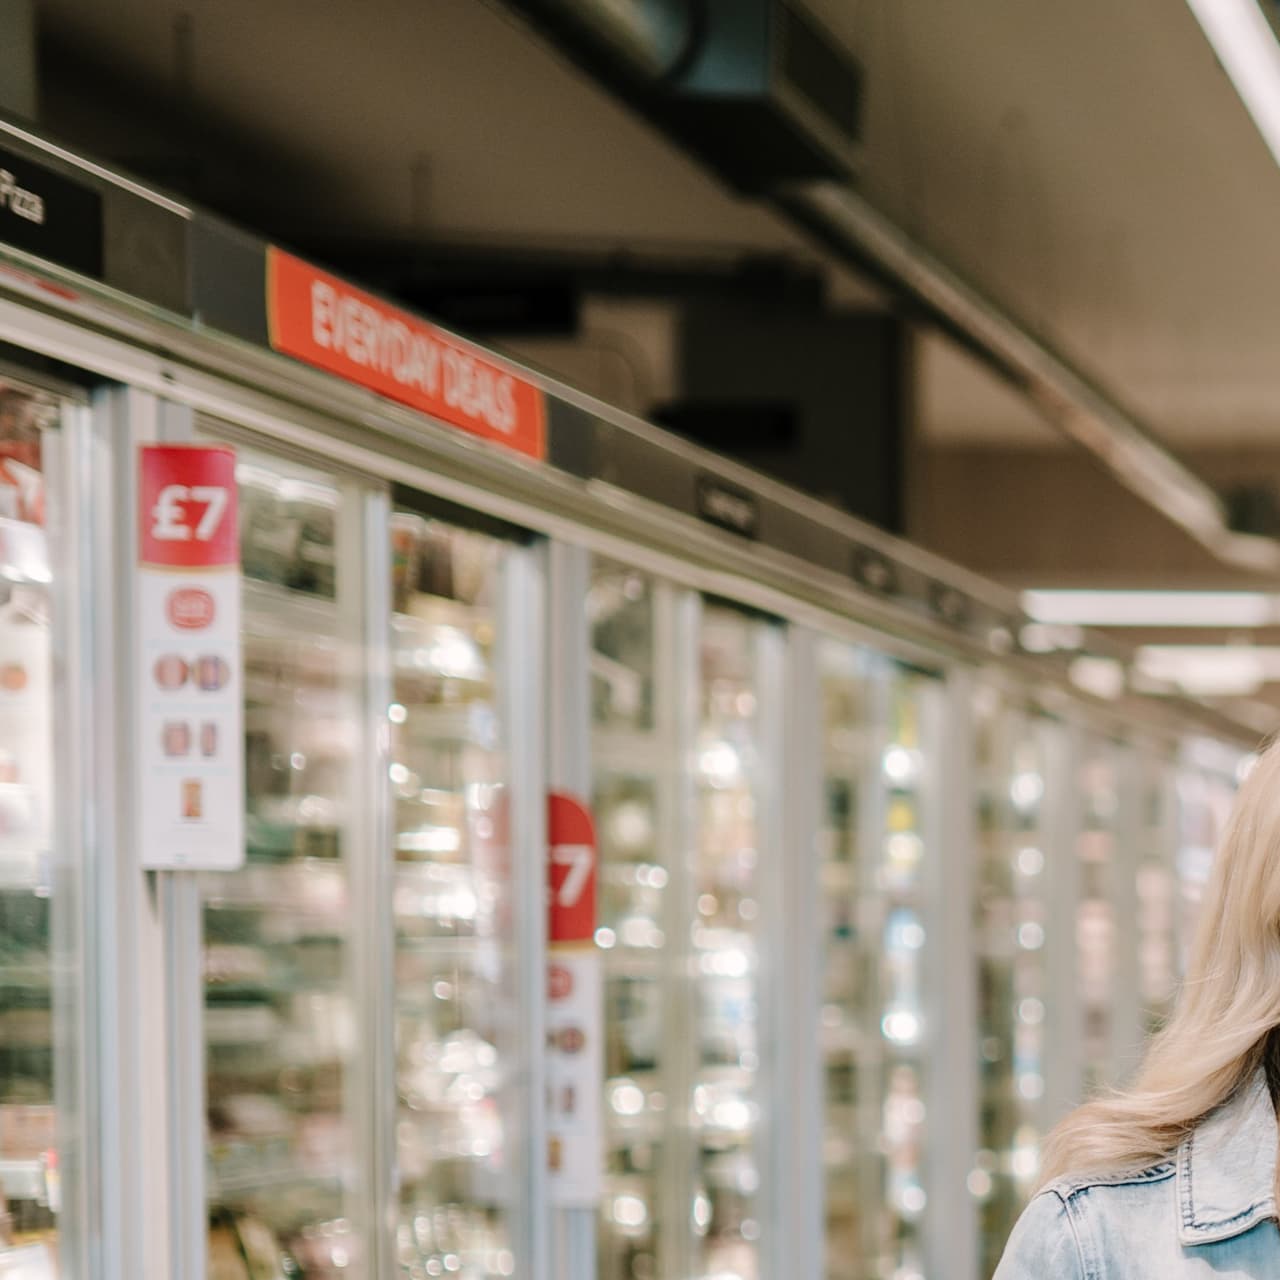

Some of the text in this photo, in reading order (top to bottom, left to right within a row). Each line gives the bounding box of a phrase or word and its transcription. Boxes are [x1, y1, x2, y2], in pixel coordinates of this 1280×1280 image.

[311, 279, 517, 435] EVERYDAY DEALS
[150, 483, 229, 543] £7
[549, 843, 595, 908] 7
